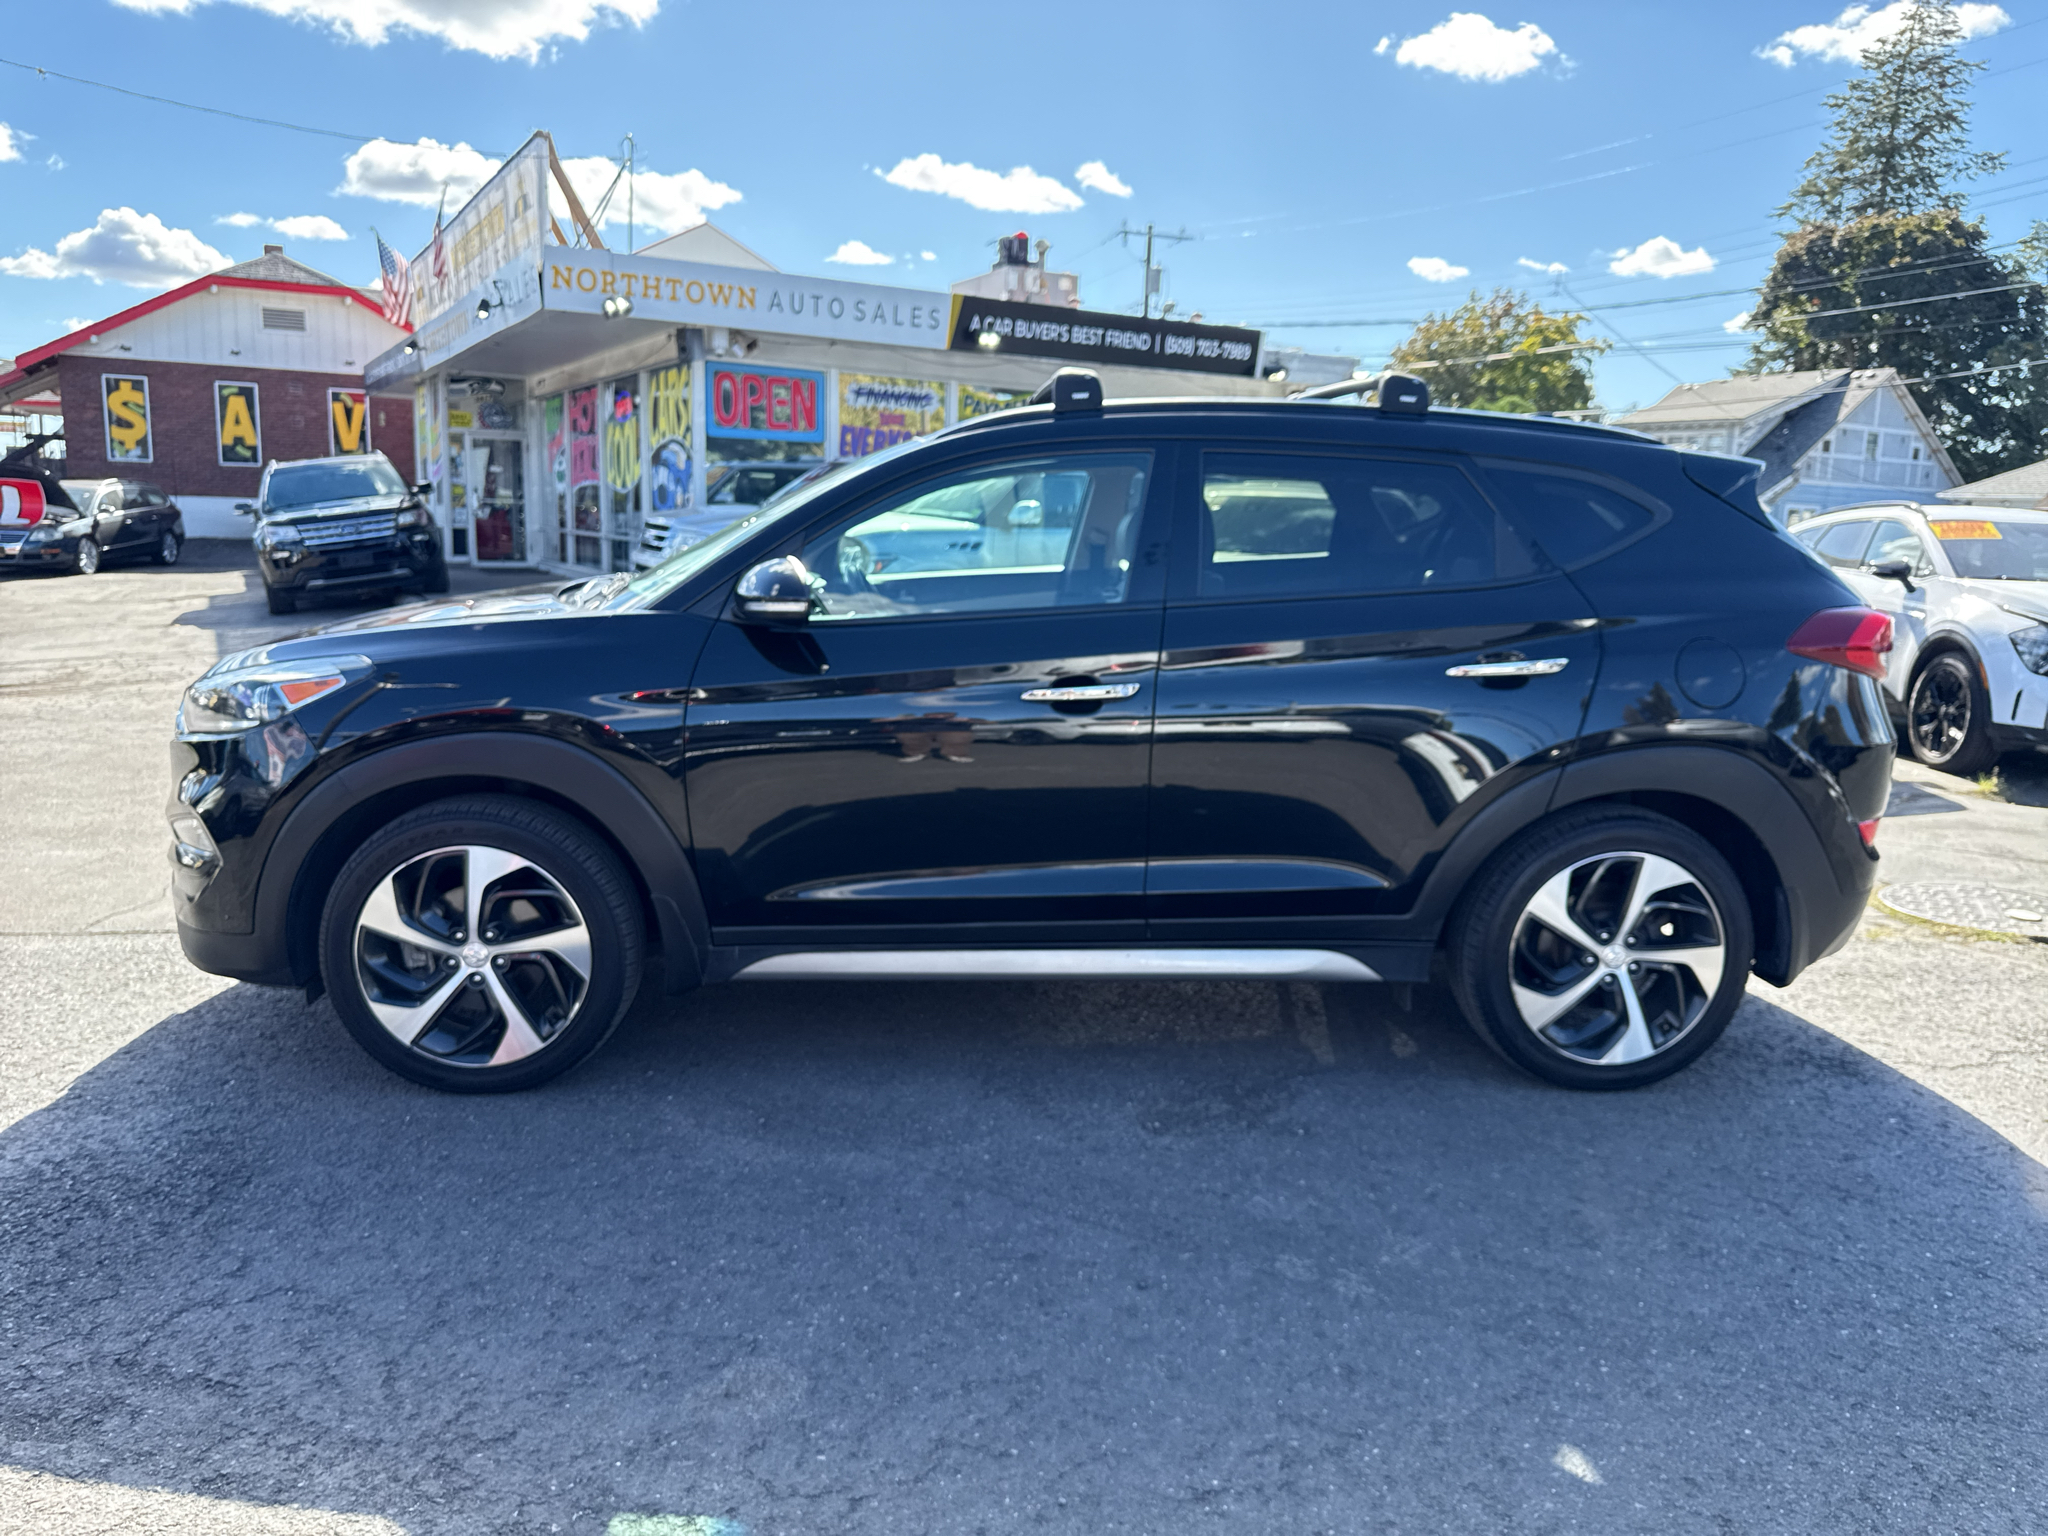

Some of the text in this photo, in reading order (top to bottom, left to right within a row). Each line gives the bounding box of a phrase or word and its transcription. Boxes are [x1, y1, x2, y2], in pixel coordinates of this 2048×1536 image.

[551, 264, 757, 309] NORTHTOWN
[969, 313, 981, 333] A
[1071, 325, 1104, 346] BEST
[1104, 327, 1151, 350] FRIEND
[713, 371, 817, 432] OPEN
[852, 385, 935, 410] FINANCING
[221, 395, 258, 447] A
